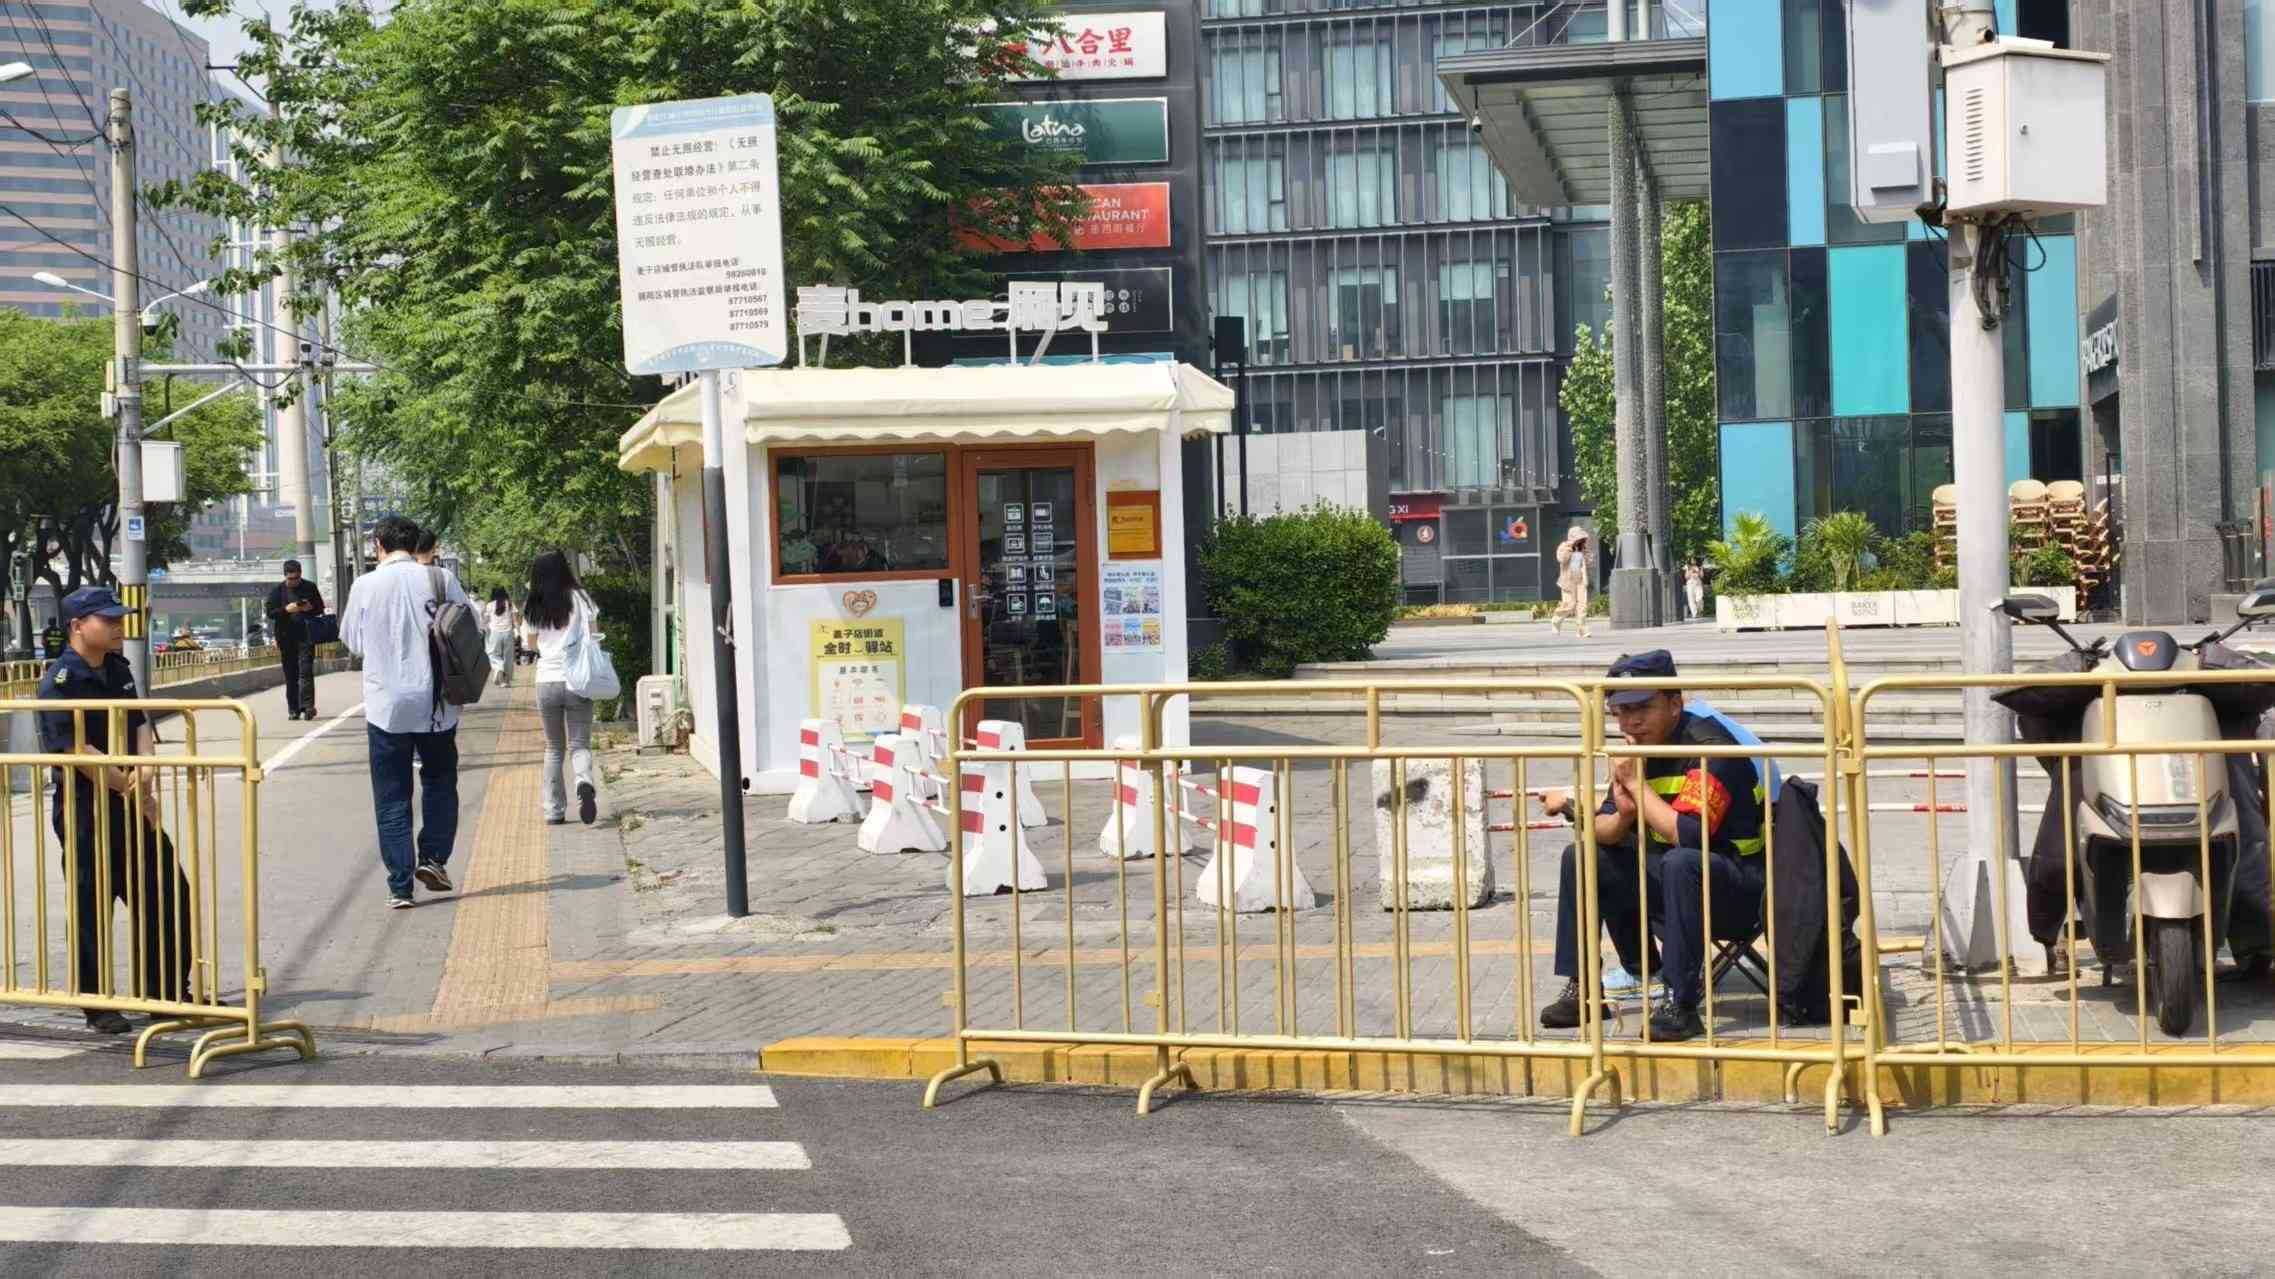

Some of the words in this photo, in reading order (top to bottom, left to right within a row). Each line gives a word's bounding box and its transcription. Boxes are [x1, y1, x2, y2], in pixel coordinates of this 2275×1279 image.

[1042, 26, 1133, 55] 八合里
[1022, 114, 1086, 143] Latina
